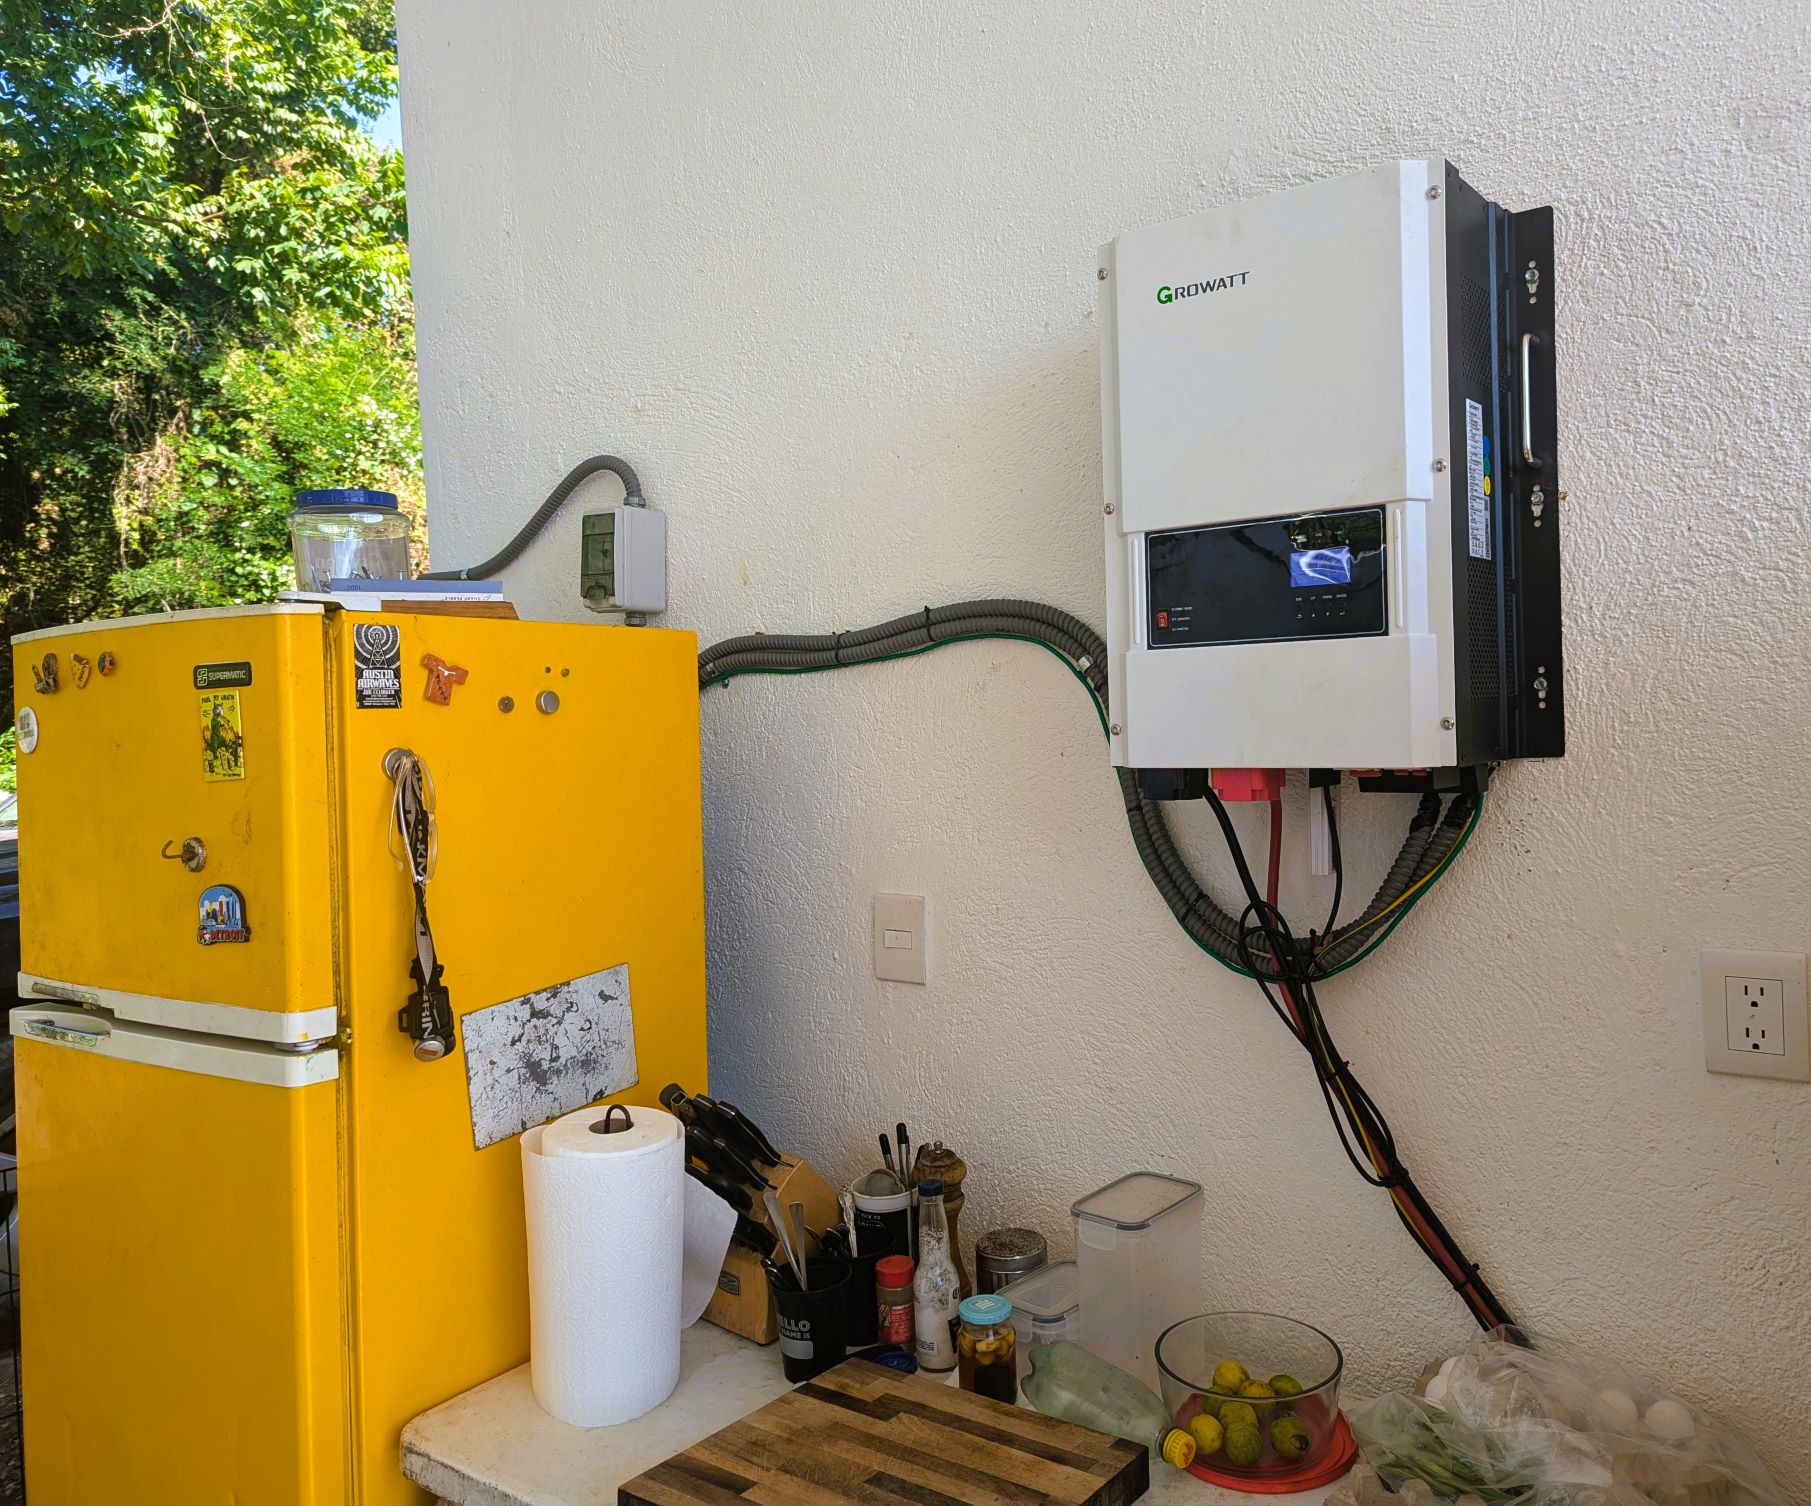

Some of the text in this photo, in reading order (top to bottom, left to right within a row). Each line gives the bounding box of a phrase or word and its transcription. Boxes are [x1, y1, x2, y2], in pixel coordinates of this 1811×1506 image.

[1156, 271, 1250, 305] GROWATT
[208, 670, 246, 681] SUPERMATIC
[362, 669, 394, 679] AUSTIN
[357, 678, 400, 688] AIRWAVES
[211, 929, 244, 942] DETROIT
